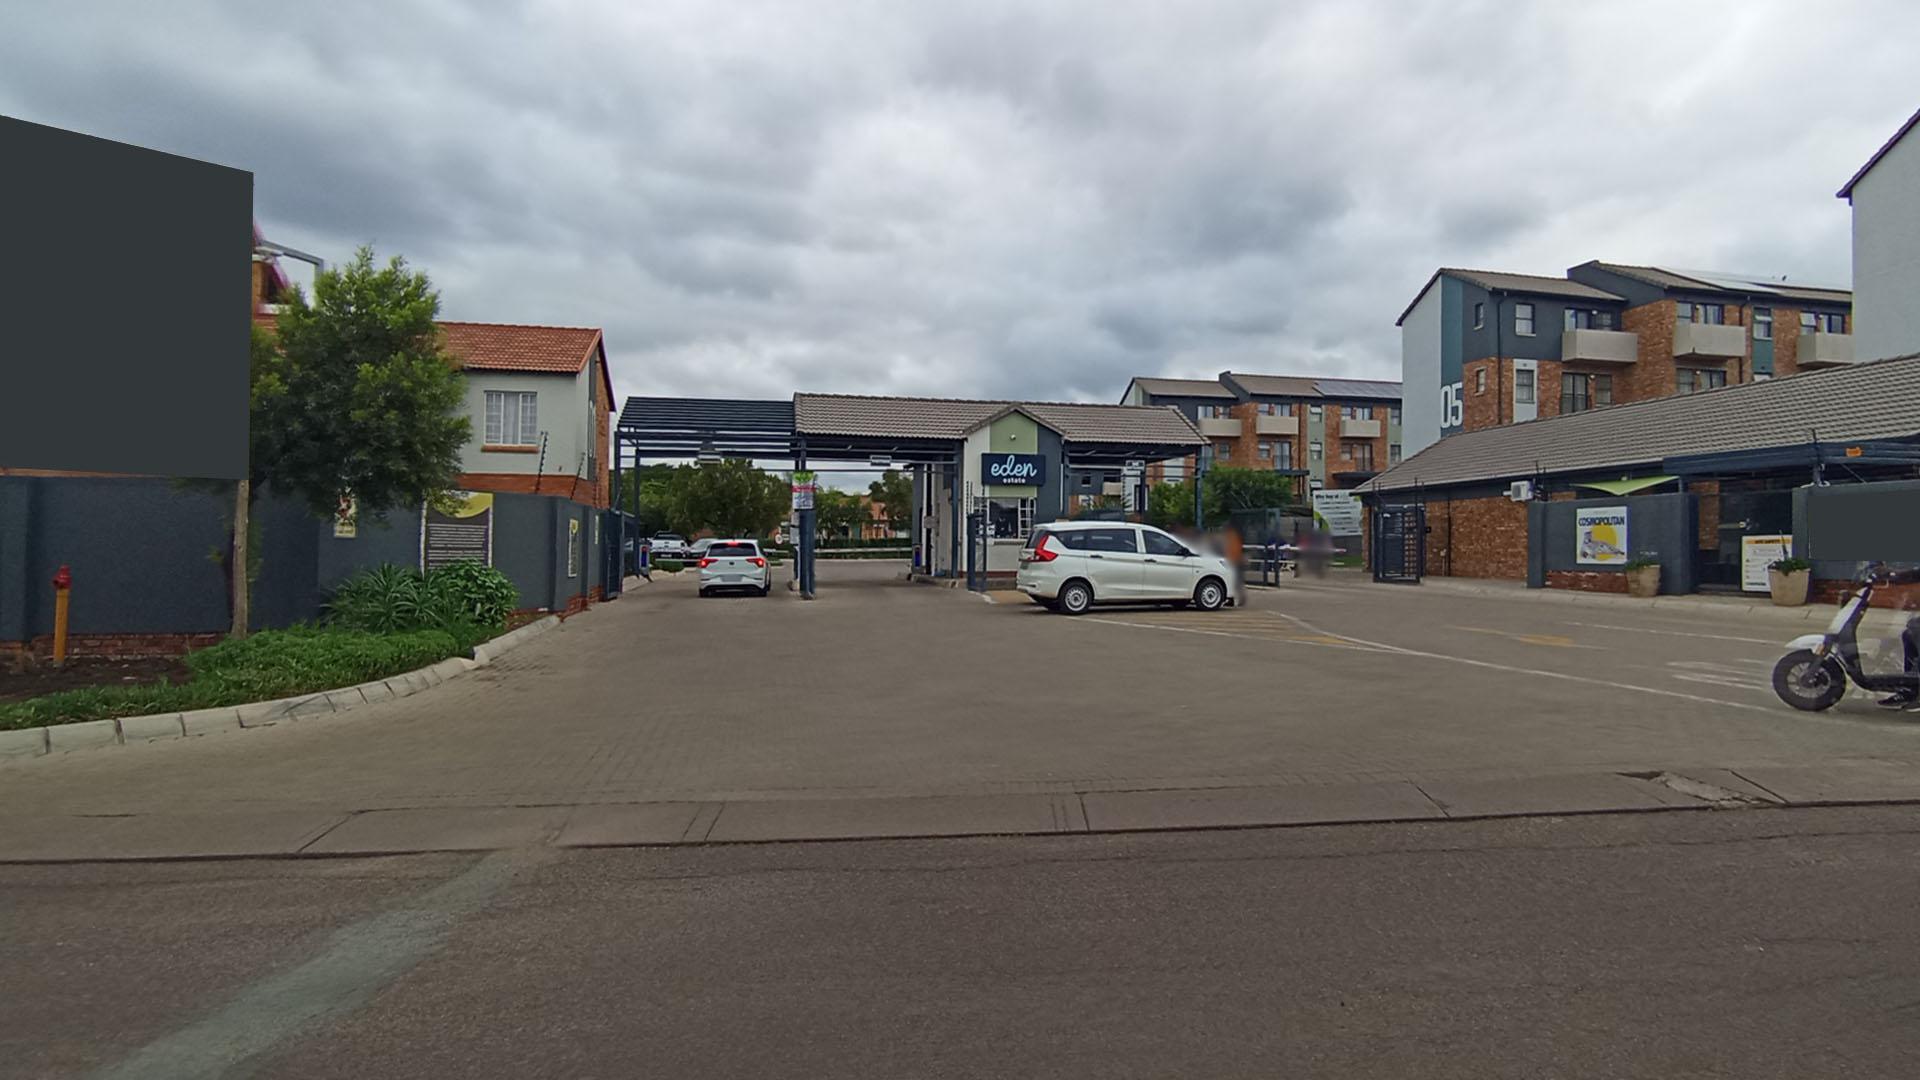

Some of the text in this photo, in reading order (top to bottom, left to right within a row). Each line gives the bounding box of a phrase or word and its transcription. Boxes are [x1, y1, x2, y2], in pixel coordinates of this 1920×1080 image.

[1440, 382, 1462, 428] 05
[991, 455, 1037, 477] eden
[1578, 516, 1625, 526] COSMOPOLITAN
